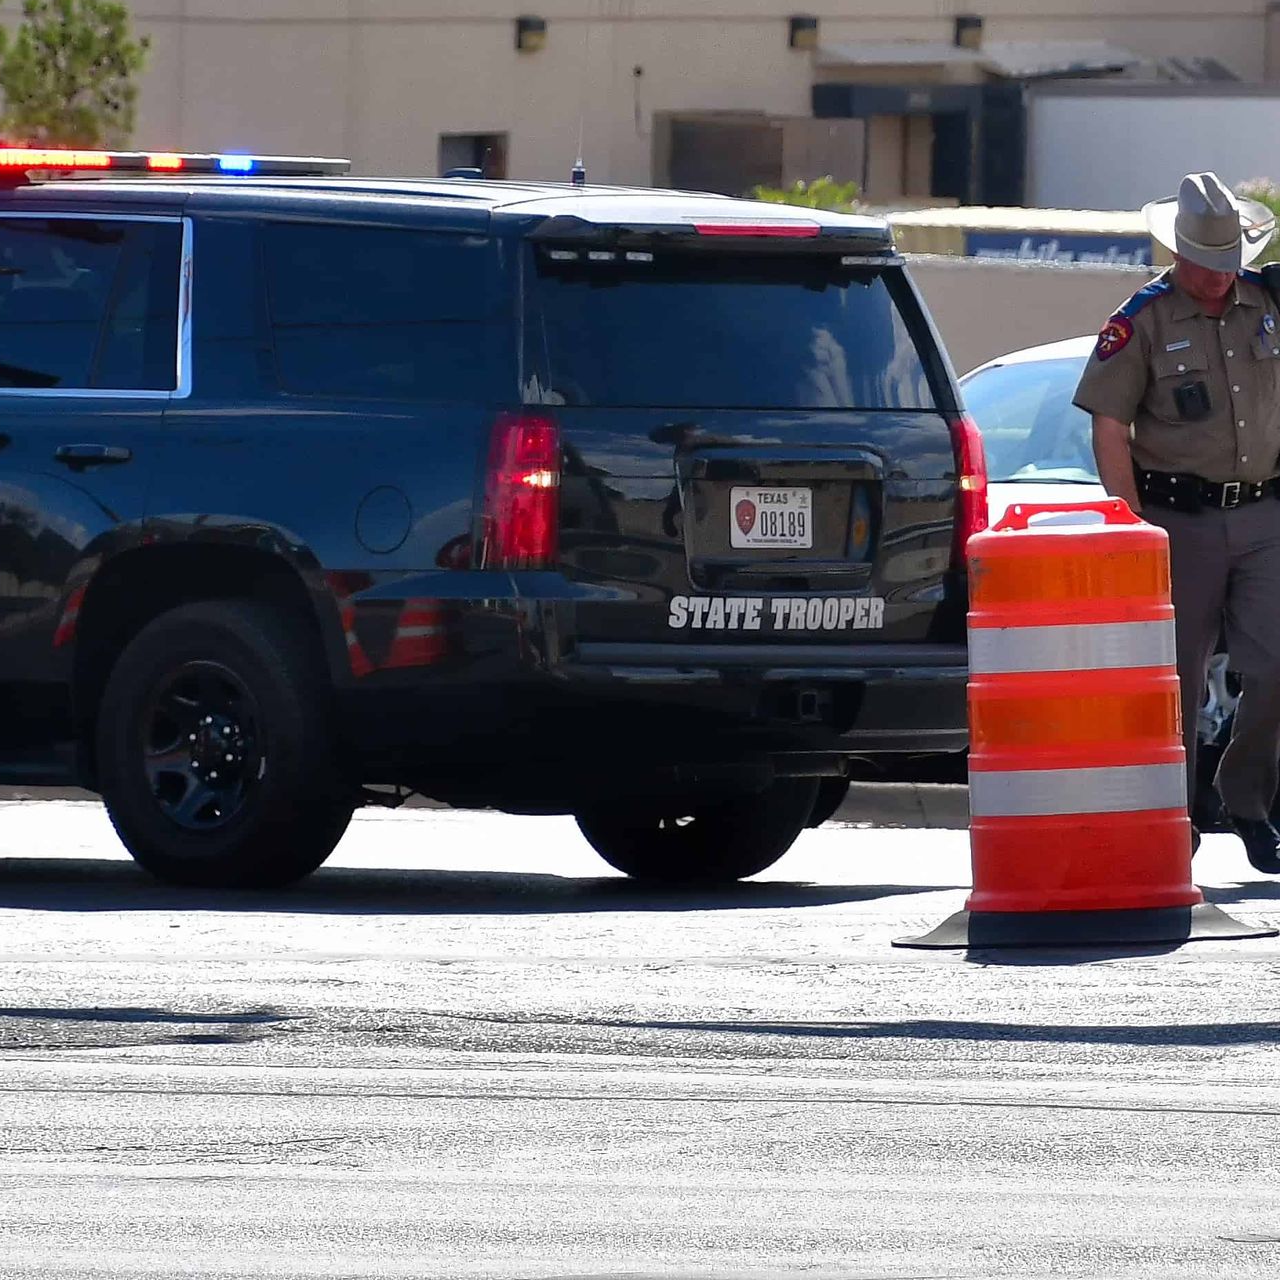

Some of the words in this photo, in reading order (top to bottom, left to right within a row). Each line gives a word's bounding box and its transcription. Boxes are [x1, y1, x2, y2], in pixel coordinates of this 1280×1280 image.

[758, 493, 788, 504] TEXAS
[760, 511, 805, 537] 08189
[669, 596, 763, 629] STATE
[771, 597, 885, 630] TROOPER
